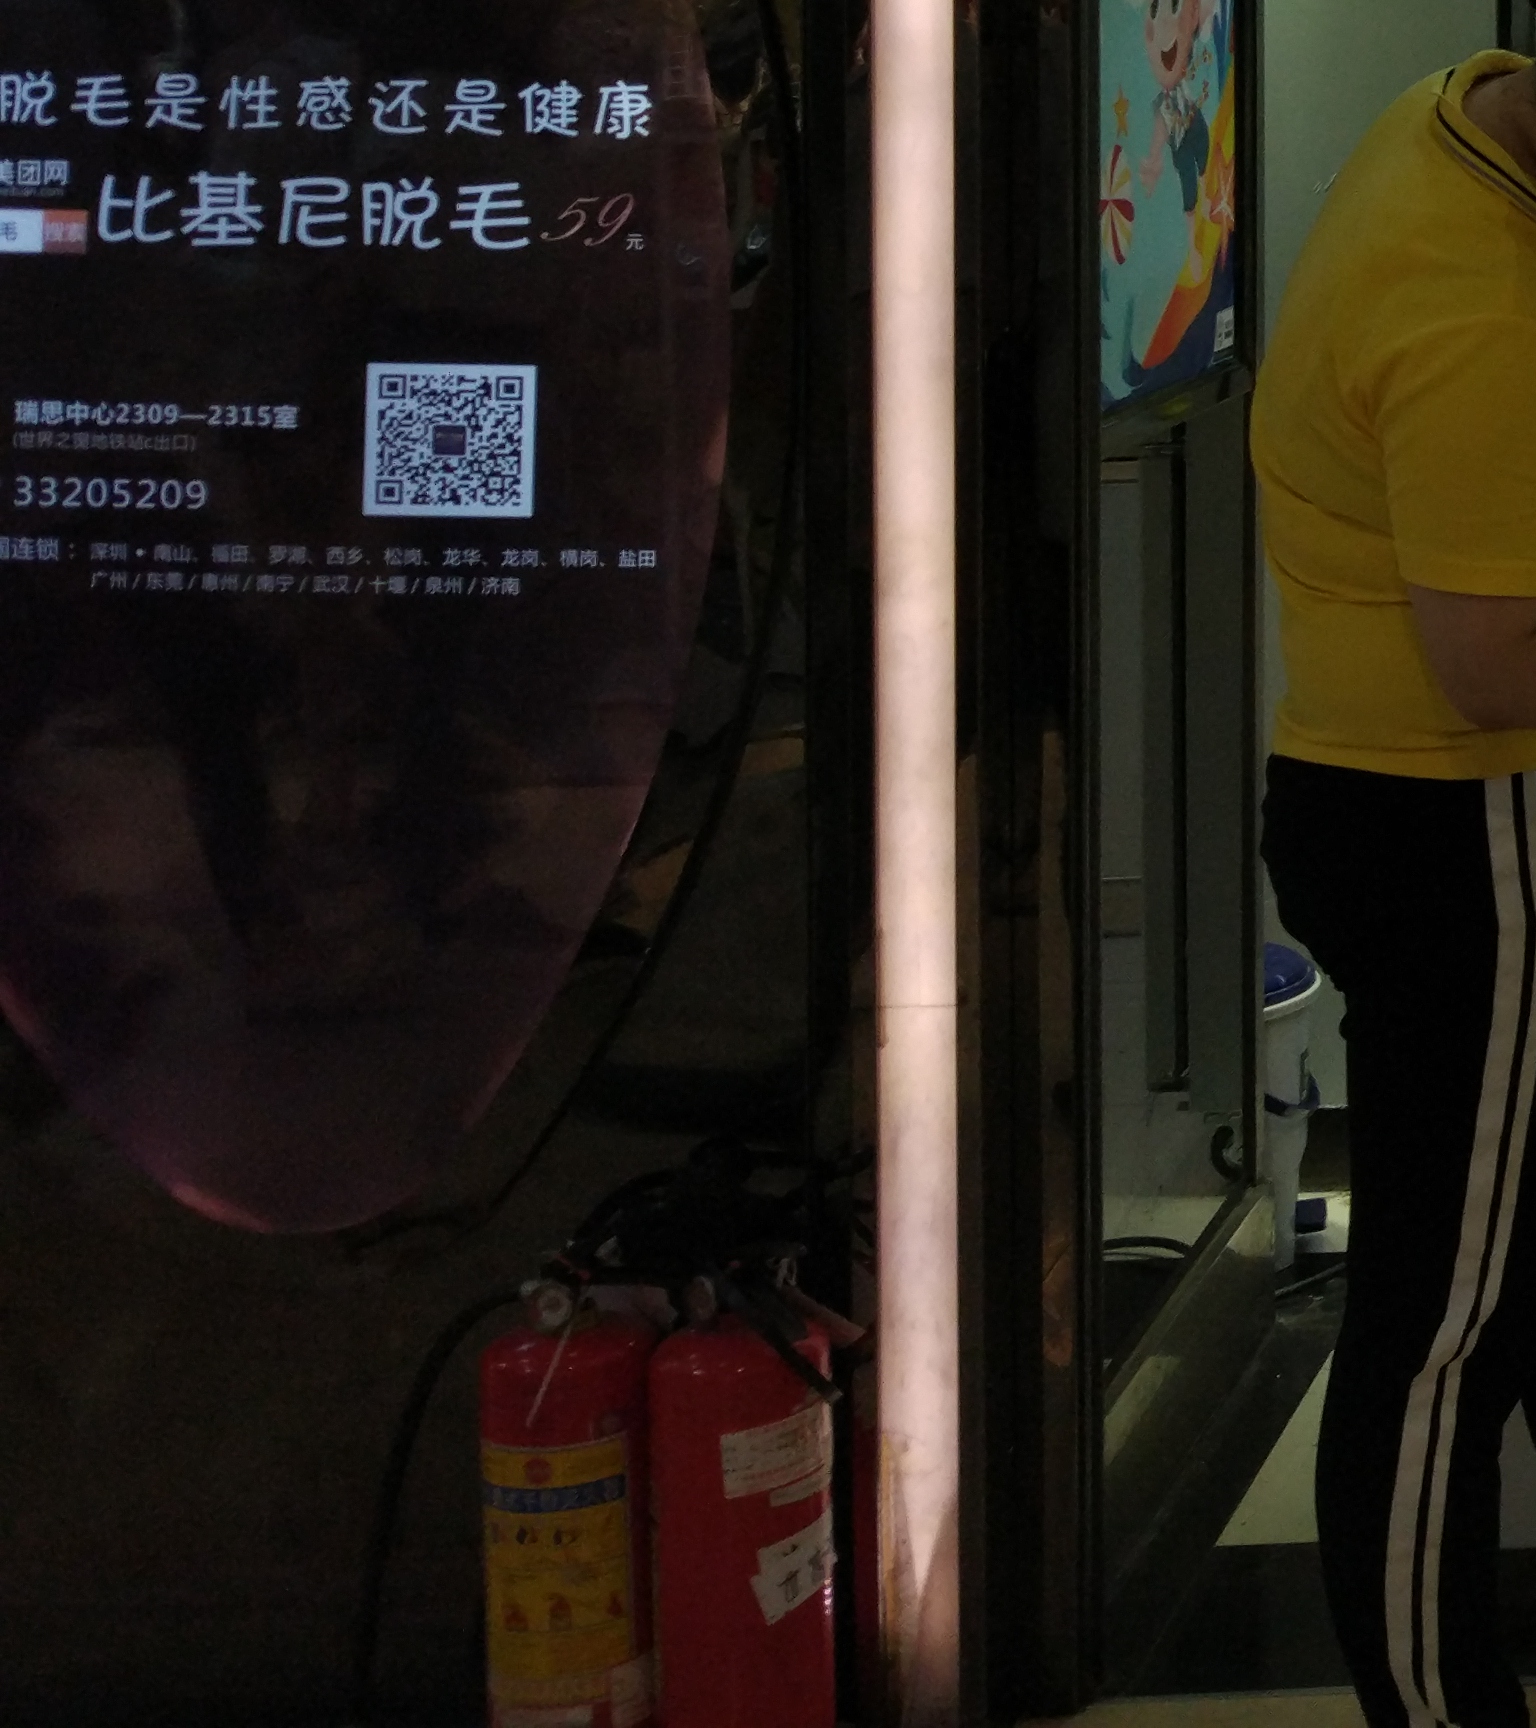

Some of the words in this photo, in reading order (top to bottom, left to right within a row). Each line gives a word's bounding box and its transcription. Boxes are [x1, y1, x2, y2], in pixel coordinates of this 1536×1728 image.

[0, 72, 655, 140] 脱毛是性感还是健康
[97, 170, 533, 251] 比基尼脱毛
[13, 474, 211, 511] 33205209
